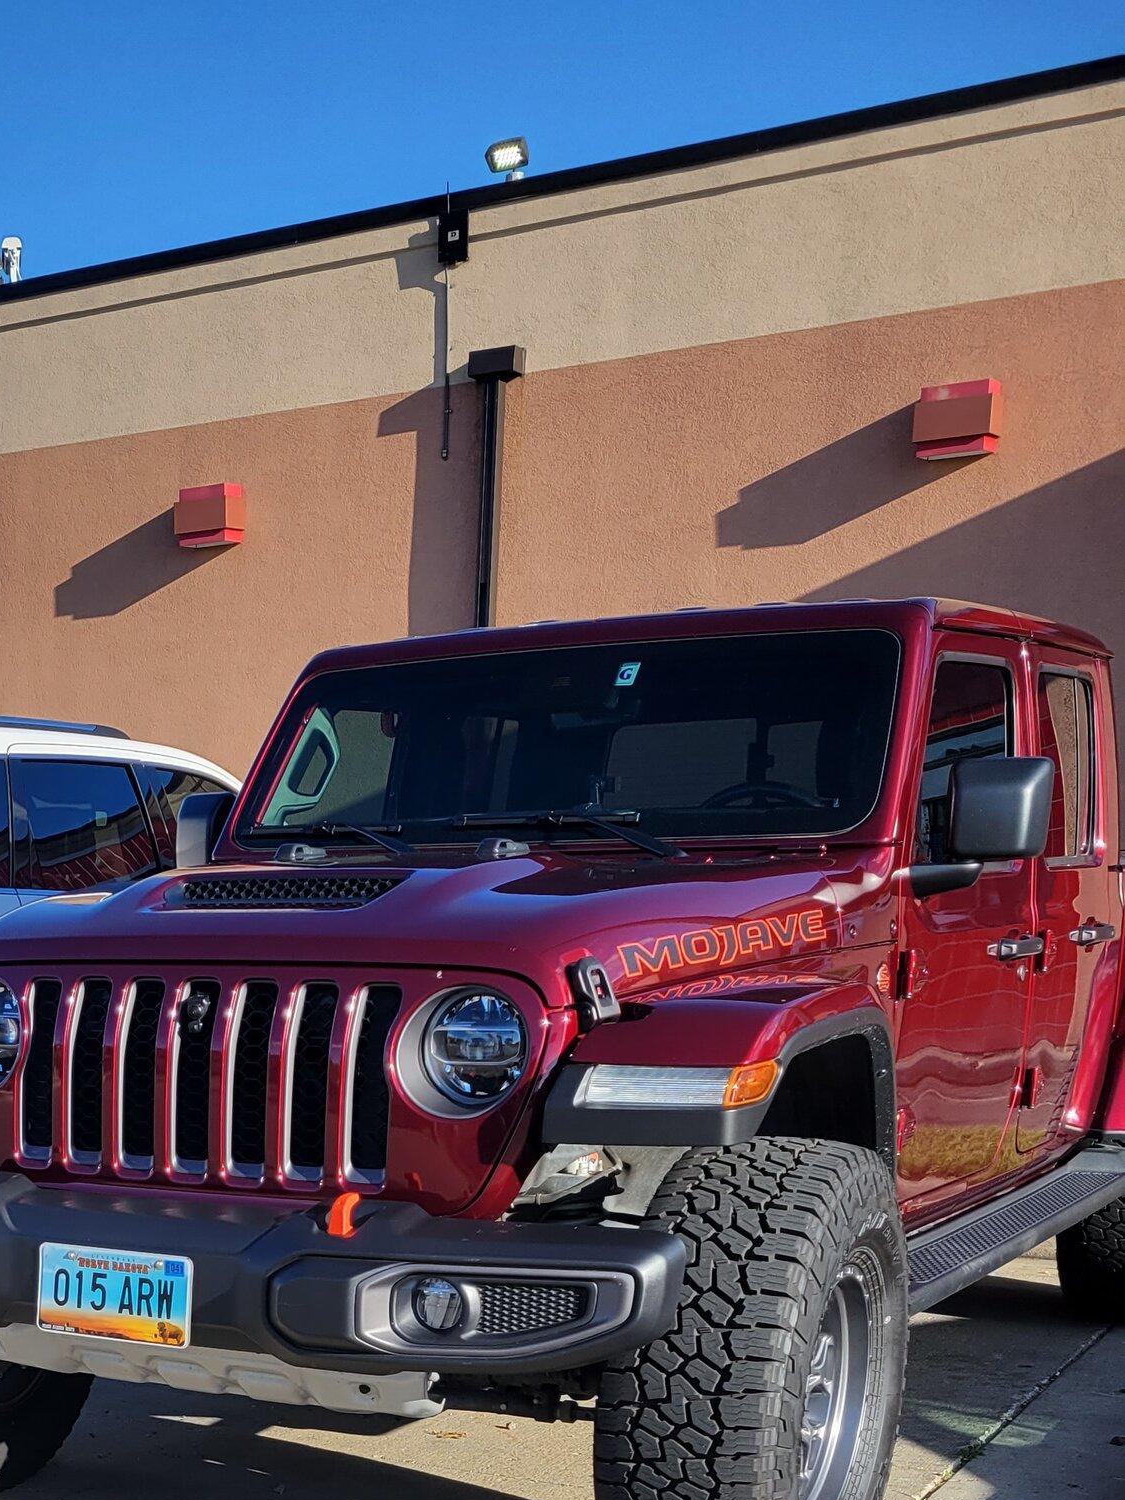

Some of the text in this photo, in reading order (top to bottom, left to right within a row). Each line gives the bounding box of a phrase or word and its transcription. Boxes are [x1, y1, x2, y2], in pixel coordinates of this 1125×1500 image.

[617, 909, 828, 978] MOJAVE
[77, 1257, 150, 1275] NORTH DAKOTA
[53, 1268, 174, 1320] 015 ARW
